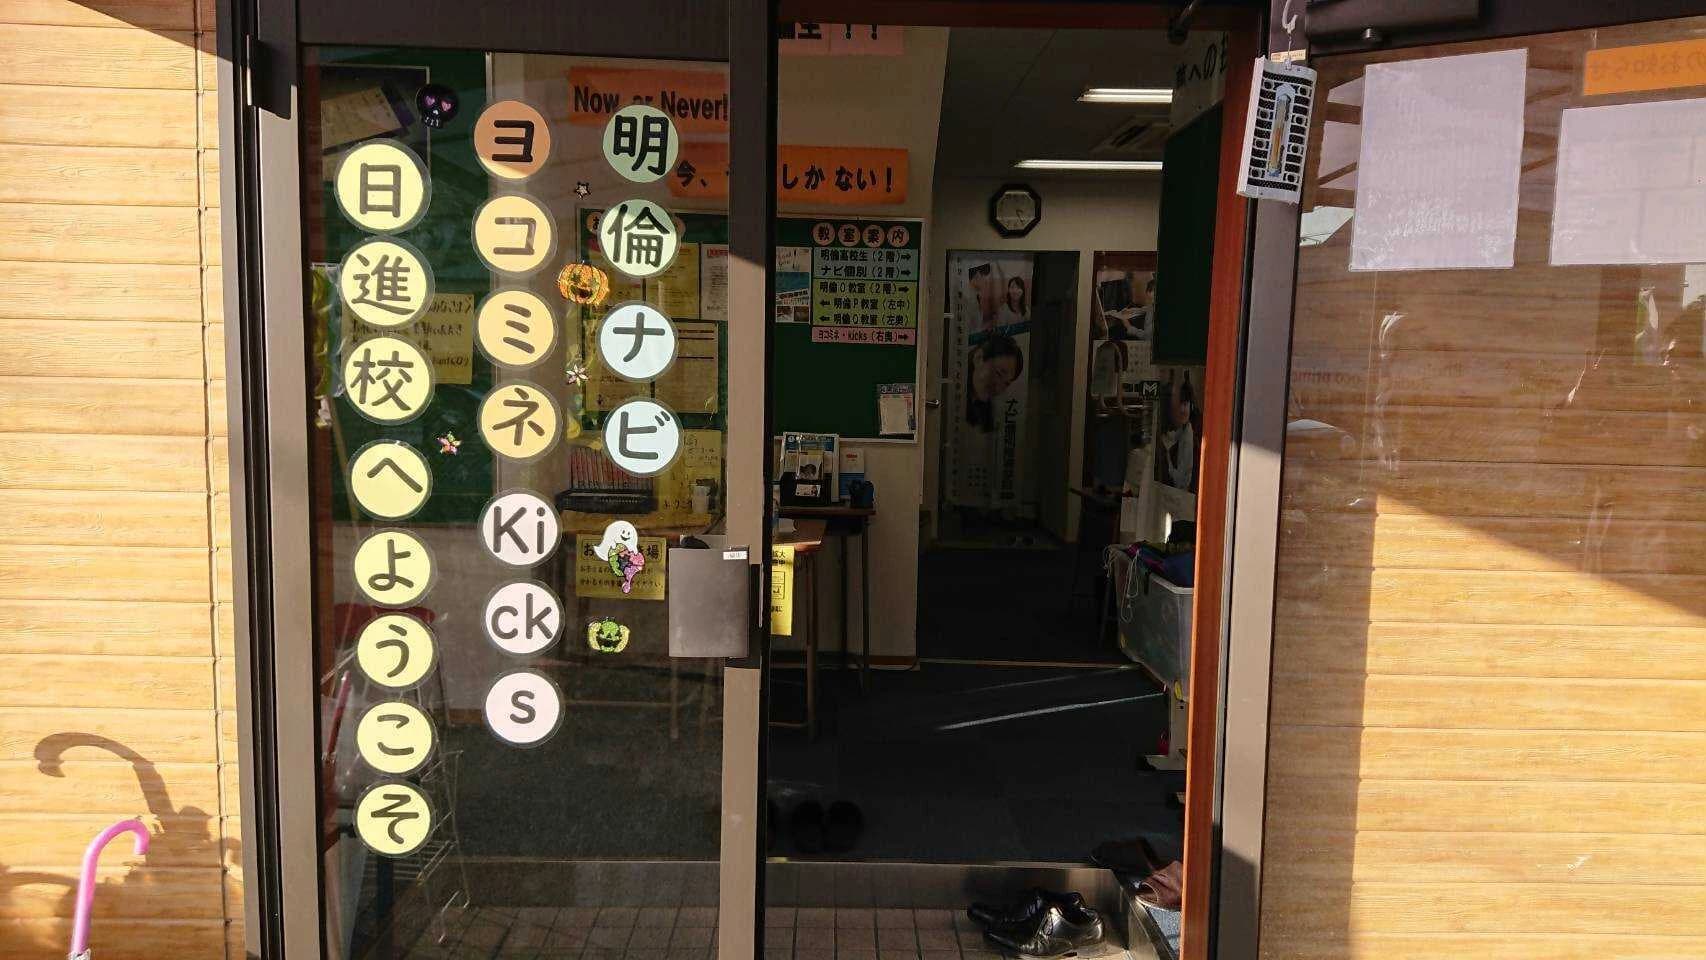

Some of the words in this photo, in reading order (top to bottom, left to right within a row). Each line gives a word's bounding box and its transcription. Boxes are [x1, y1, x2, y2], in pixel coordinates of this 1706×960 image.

[573, 85, 619, 113] Now
[490, 119, 547, 447] ヨコミネ
[350, 162, 424, 846] 日進校へようこそ
